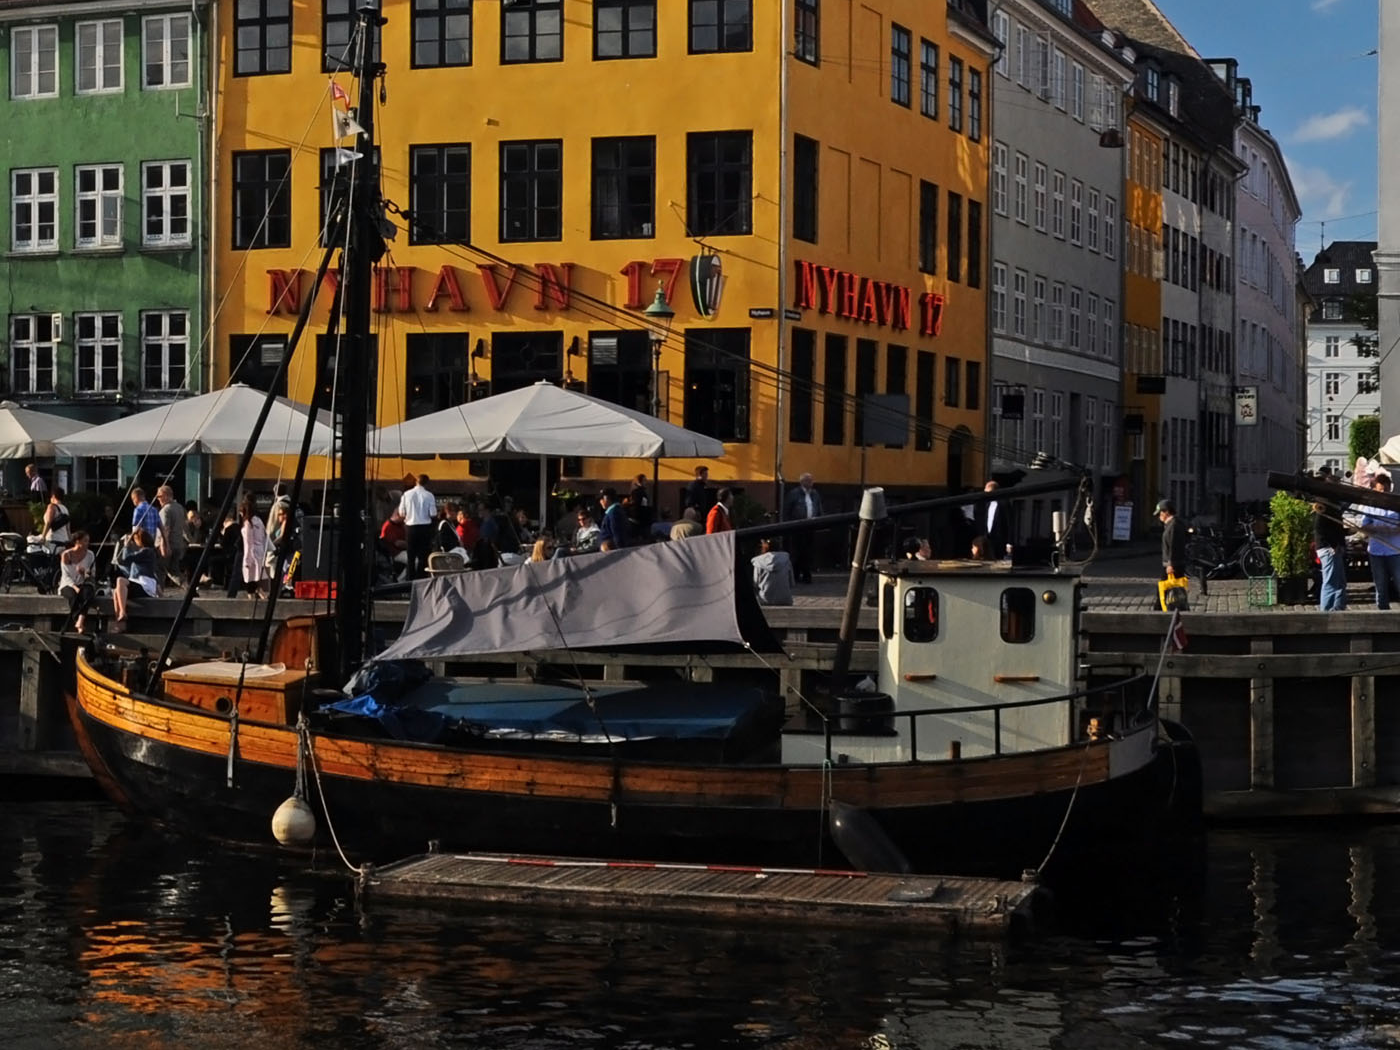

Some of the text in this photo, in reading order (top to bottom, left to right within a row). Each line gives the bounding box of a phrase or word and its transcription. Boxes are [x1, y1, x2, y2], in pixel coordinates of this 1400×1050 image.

[621, 258, 684, 310] 17
[796, 260, 945, 336] NYHAVN 17
